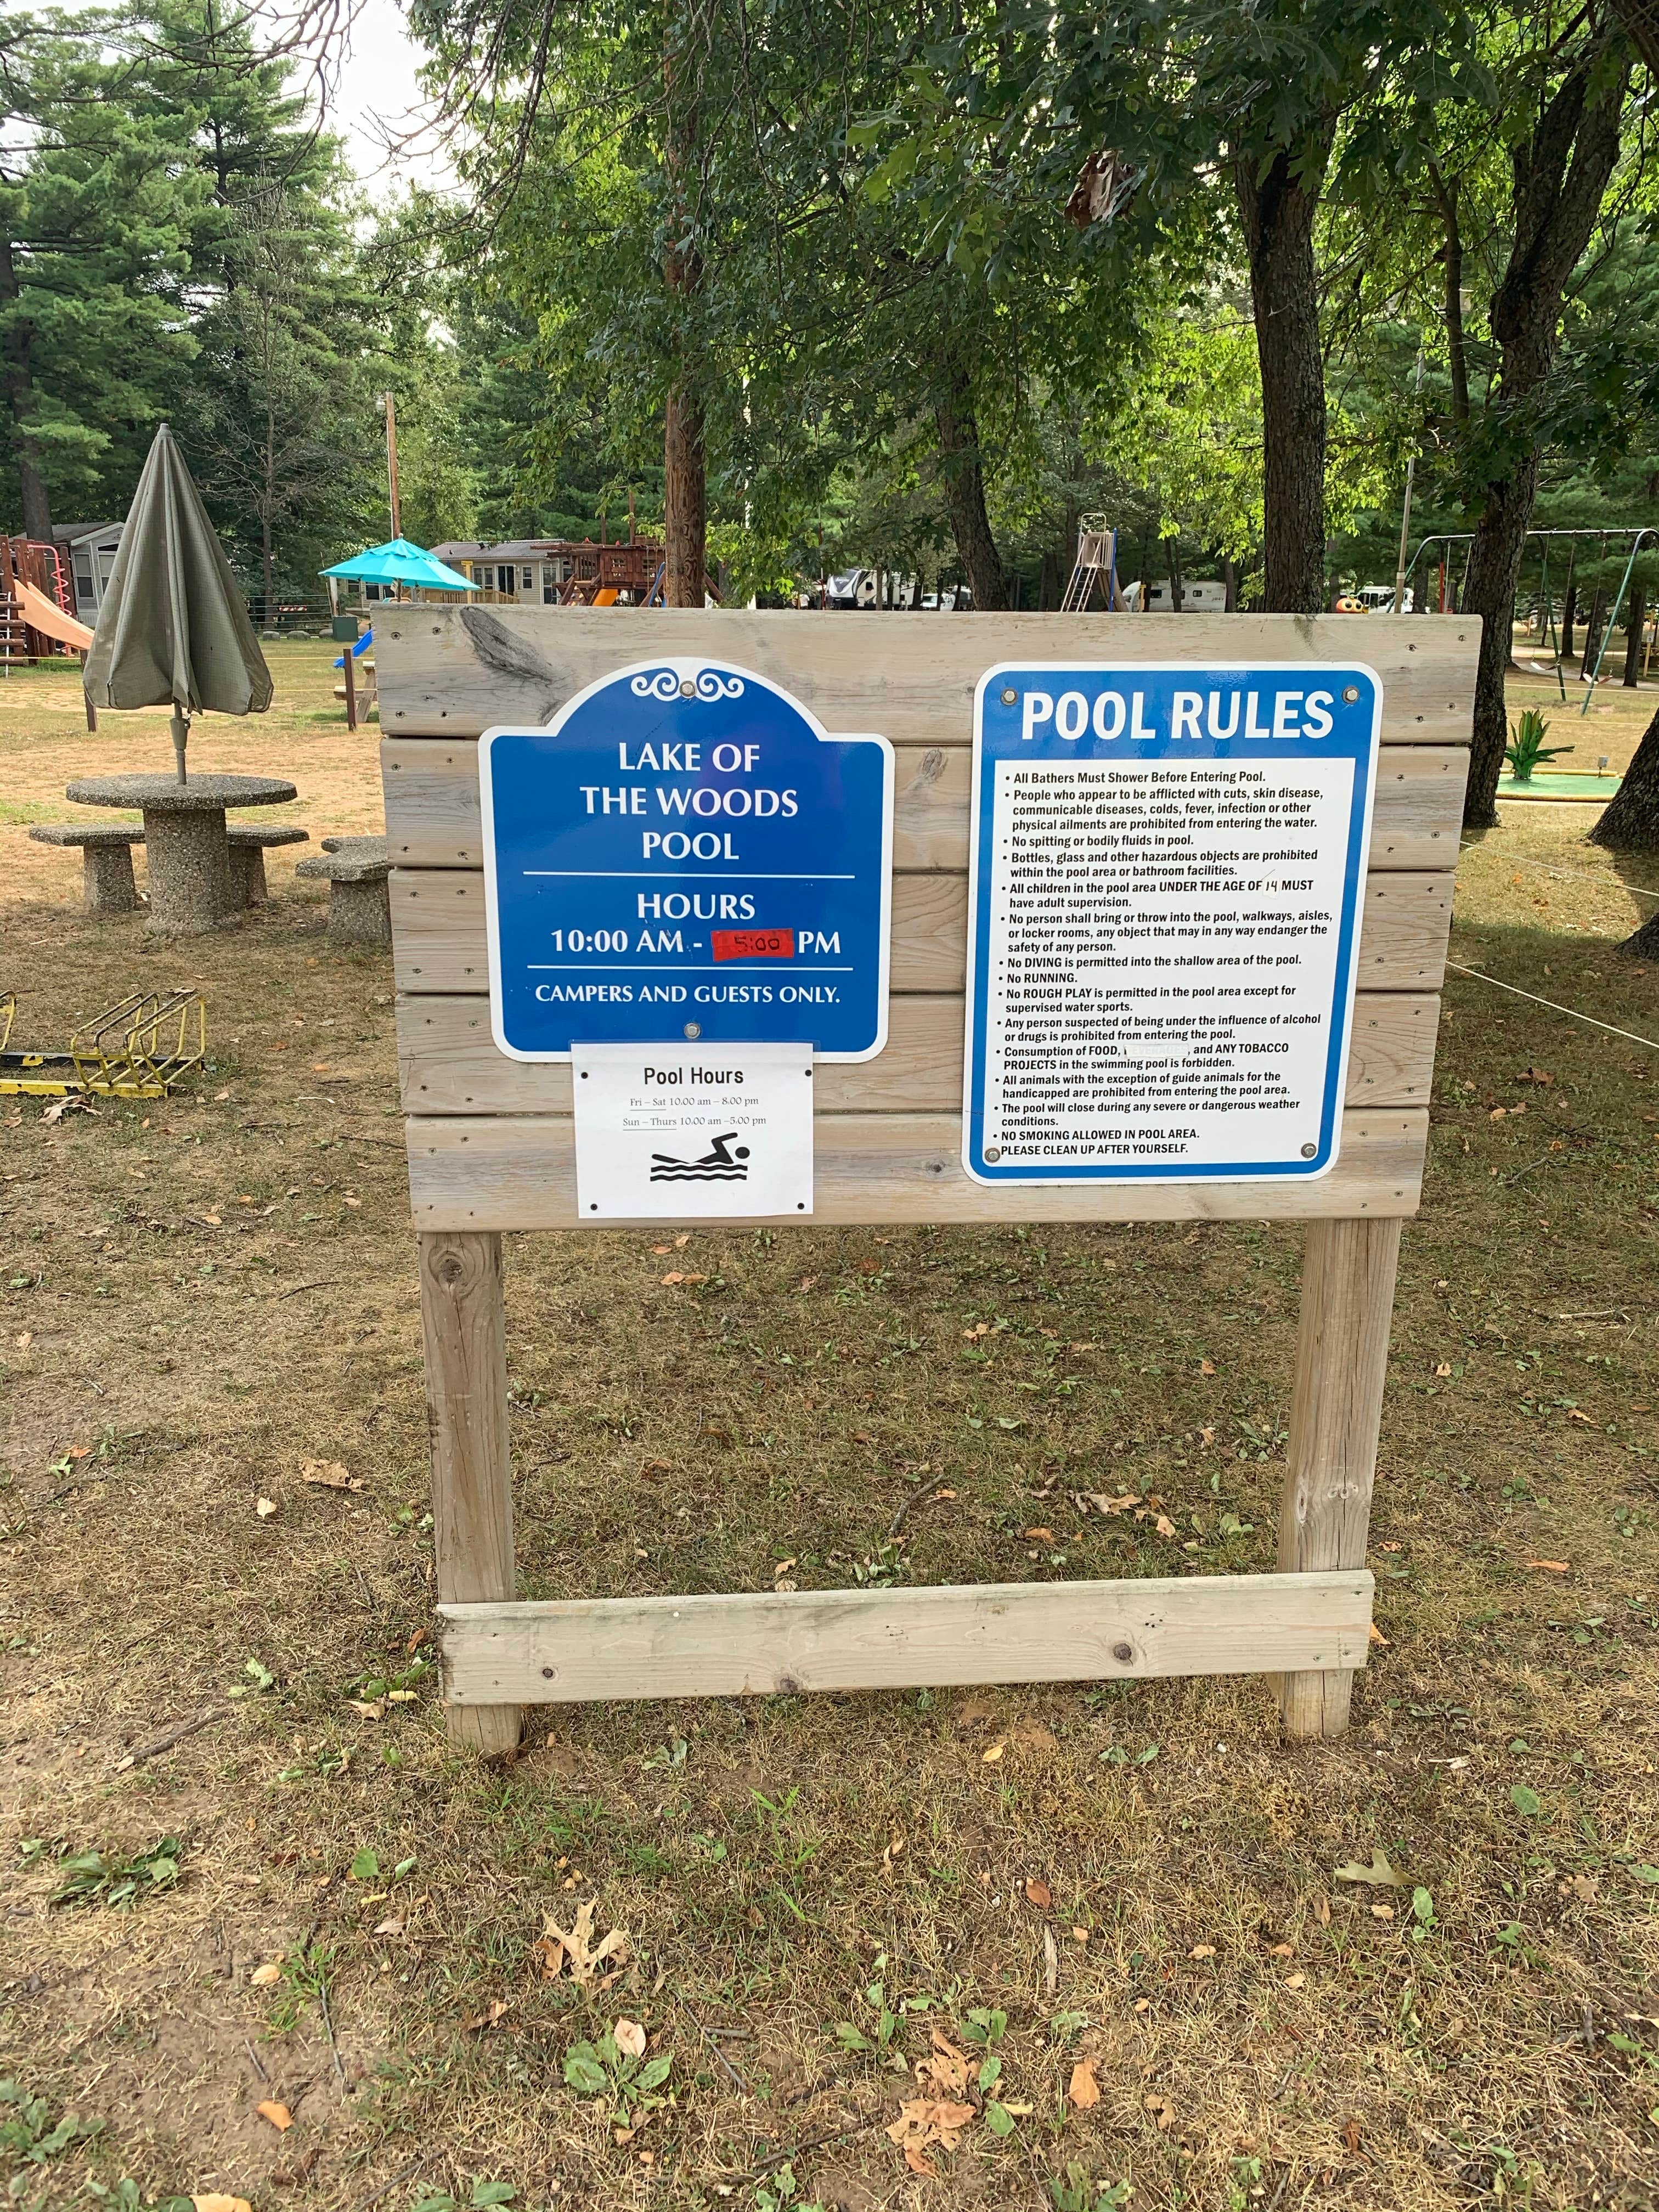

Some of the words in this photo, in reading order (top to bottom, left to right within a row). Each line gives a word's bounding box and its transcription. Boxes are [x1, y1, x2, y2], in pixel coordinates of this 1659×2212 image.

[1023, 692, 1155, 740] POOL
[1171, 691, 1333, 738] RULES
[619, 743, 700, 771] LAKE
[713, 744, 759, 771] OF
[1014, 773, 1028, 783] All
[1032, 773, 1074, 783] Bathers
[1078, 772, 1105, 783] Must
[1108, 772, 1149, 782] Shower
[1152, 771, 1187, 782] Before
[1190, 771, 1237, 784] Entering
[1239, 771, 1265, 781] Pool.
[580, 787, 646, 814] THE
[656, 788, 798, 816] WOODS
[1014, 790, 1051, 802] People
[1054, 789, 1075, 800] who
[1079, 792, 1117, 802] appear
[1120, 789, 1130, 799] to
[1133, 789, 1146, 799] be
[1149, 788, 1195, 799] afflicted
[1198, 788, 1220, 798] with
[1224, 788, 1250, 800] cuts,
[1253, 788, 1276, 798] skin
[1279, 787, 1323, 800] disease,
[1013, 804, 1092, 815] communicable
[1096, 804, 1146, 816] diseases,
[1150, 803, 1182, 816] colds,
[1185, 803, 1214, 815] fever,
[1218, 803, 1266, 813] infection
[1282, 803, 1311, 812] other
[644, 832, 738, 859] POOL
[1012, 836, 1026, 847] No
[1029, 836, 1071, 849] spitting
[1087, 836, 1119, 848] bodily
[1122, 835, 1152, 845] fluids
[1155, 835, 1164, 845] in
[1167, 834, 1193, 847] pool.
[1009, 883, 1024, 893] All
[1027, 883, 1070, 893] children
[1074, 883, 1083, 893] in
[1086, 883, 1103, 893] the
[1107, 882, 1129, 895] pool
[1160, 882, 1197, 891] UNDER
[1200, 882, 1221, 891] THE
[1223, 881, 1245, 890] AGE
[1248, 881, 1262, 891] OF
[1266, 881, 1277, 892] 14
[1282, 880, 1313, 890] MUST
[638, 894, 754, 919] HOURS
[1010, 898, 1034, 908] have
[1037, 898, 1065, 907] adult
[1068, 897, 1131, 909] supervision.
[552, 930, 628, 952] 10:00
[636, 930, 683, 952] AM
[735, 936, 780, 952] 5:00
[799, 932, 840, 953] PM
[1008, 958, 1022, 968] No
[1025, 957, 1062, 968] DIVING
[1065, 957, 1074, 967] is
[1076, 957, 1128, 969] permitted
[1131, 957, 1151, 966] into
[1154, 956, 1171, 966] the
[1174, 956, 1214, 966] shallow
[1243, 955, 1254, 964] of
[1256, 955, 1273, 964] the
[1276, 955, 1301, 967] pool.
[1007, 974, 1021, 983] No
[1024, 973, 1077, 983] RUNNING.
[536, 985, 633, 1001] CAMPERS
[639, 986, 686, 1001] AND
[695, 986, 772, 1002] GUESTS
[780, 987, 839, 1002] ONLY.
[1007, 989, 1020, 998] No
[1024, 989, 1062, 998] ROUGH
[1065, 988, 1092, 998] PLAY
[1094, 988, 1103, 997] is
[1106, 988, 1157, 1000] permitted
[1160, 987, 1169, 997] in
[1172, 987, 1189, 997] the
[1192, 986, 1215, 998] pool
[1244, 986, 1279, 997] except
[1282, 985, 1296, 995] for
[1006, 1002, 1062, 1014] supervised
[1065, 1002, 1094, 1012] water
[1097, 1002, 1132, 1013] sports.
[1005, 1046, 1073, 1058] Consumption
[1076, 1046, 1086, 1056] of
[1089, 1046, 1120, 1057] FOOD,
[1194, 1044, 1213, 1054] and
[1215, 1044, 1237, 1053] ANY
[1239, 1043, 1289, 1053] TOBACCO
[1004, 1060, 1056, 1070] PROJECTS
[1059, 1060, 1069, 1069] in
[1071, 1060, 1088, 1069] the
[1091, 1059, 1143, 1070] swimming
[1146, 1058, 1167, 1070] pool
[1171, 1058, 1179, 1068] is
[1182, 1058, 1234, 1068] forbidden.
[645, 1068, 682, 1084] Pool
[691, 1067, 743, 1084] Hours
[1003, 1075, 1017, 1085] All
[1019, 1075, 1060, 1085] animals
[1063, 1075, 1084, 1084] with
[1087, 1074, 1104, 1084] the
[1107, 1074, 1156, 1085] exception
[1160, 1073, 1170, 1082] of
[1172, 1073, 1201, 1085] guide
[1204, 1072, 1244, 1082] animals
[1247, 1071, 1262, 1081] for
[1264, 1071, 1280, 1081] the
[1002, 1104, 1020, 1113] The
[1023, 1103, 1045, 1115] pool
[1047, 1103, 1065, 1112] will
[1068, 1103, 1094, 1112] close
[1097, 1102, 1131, 1113] during
[1133, 1104, 1151, 1113] any
[1202, 1101, 1256, 1112] dangerous
[1259, 1099, 1300, 1109] weather
[1002, 1116, 1058, 1126] conditions.
[1002, 1131, 1016, 1141] NO
[1019, 1131, 1069, 1141] SMOKING
[1072, 1130, 1121, 1139] ALLOWED
[1125, 1130, 1135, 1139] IN
[1138, 1130, 1166, 1139] POOL
[1168, 1129, 1199, 1138] AREA.
[1001, 1146, 1041, 1155] PLEASE
[1043, 1146, 1077, 1155] CLEAN
[1081, 1145, 1095, 1154] UP
[1097, 1144, 1130, 1154] AFTER
[1132, 1144, 1188, 1153] YOURSELF.
